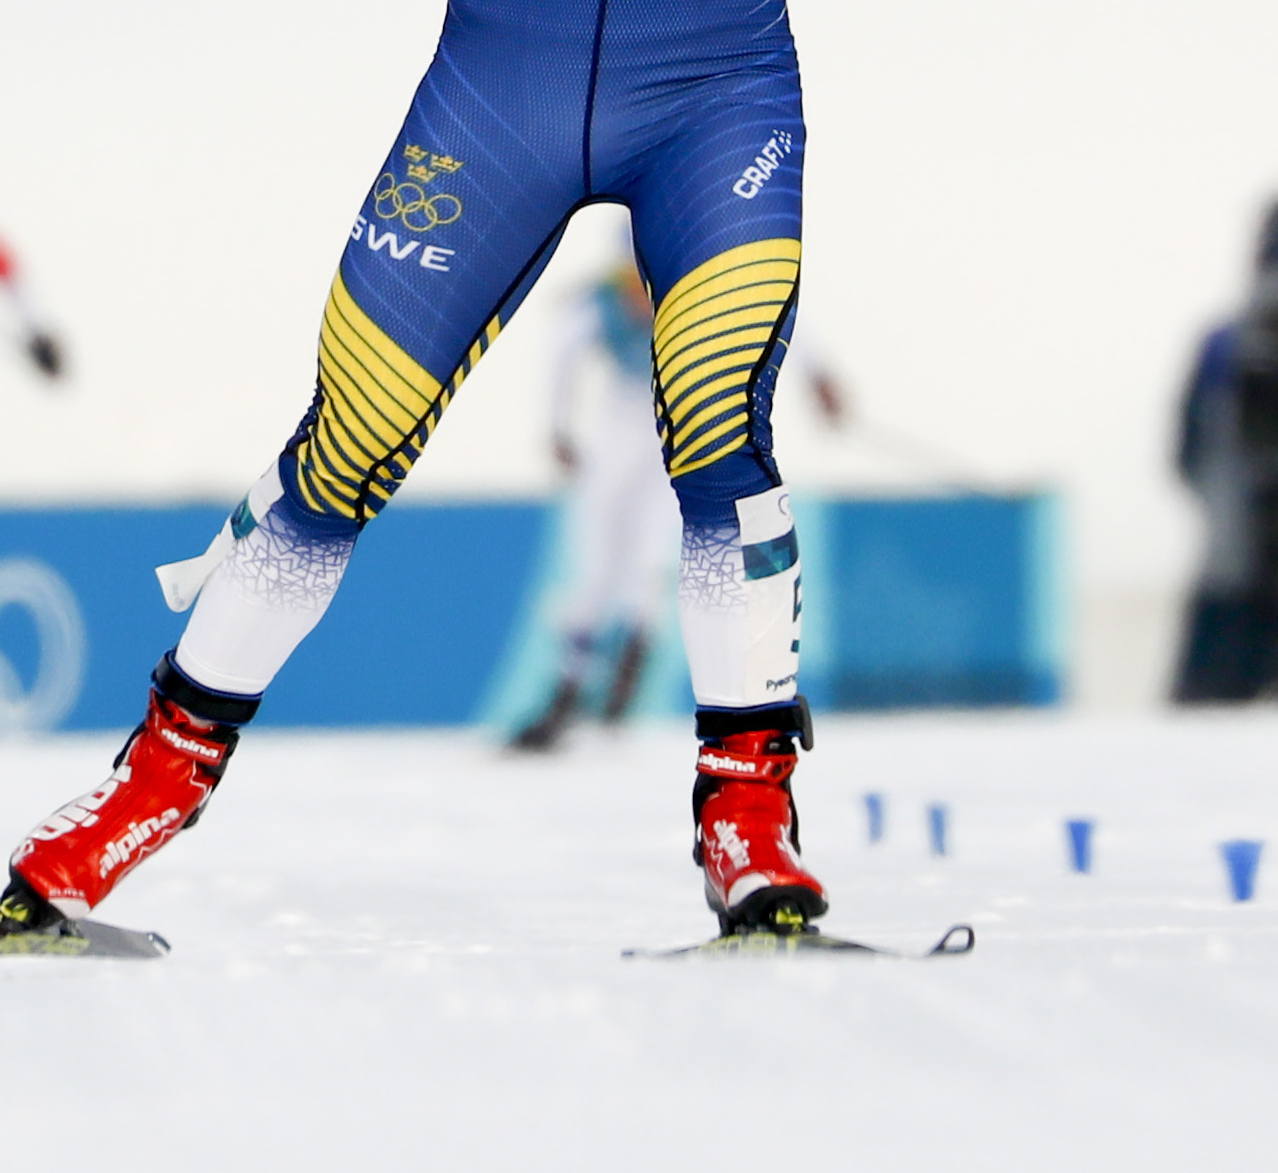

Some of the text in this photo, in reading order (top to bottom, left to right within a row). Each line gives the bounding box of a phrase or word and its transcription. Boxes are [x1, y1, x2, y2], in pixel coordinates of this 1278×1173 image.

[732, 137, 785, 200] CRAFT
[350, 214, 456, 272] SWE
[160, 727, 219, 759] alpina
[698, 753, 756, 773] alpina
[98, 806, 181, 879] alpina
